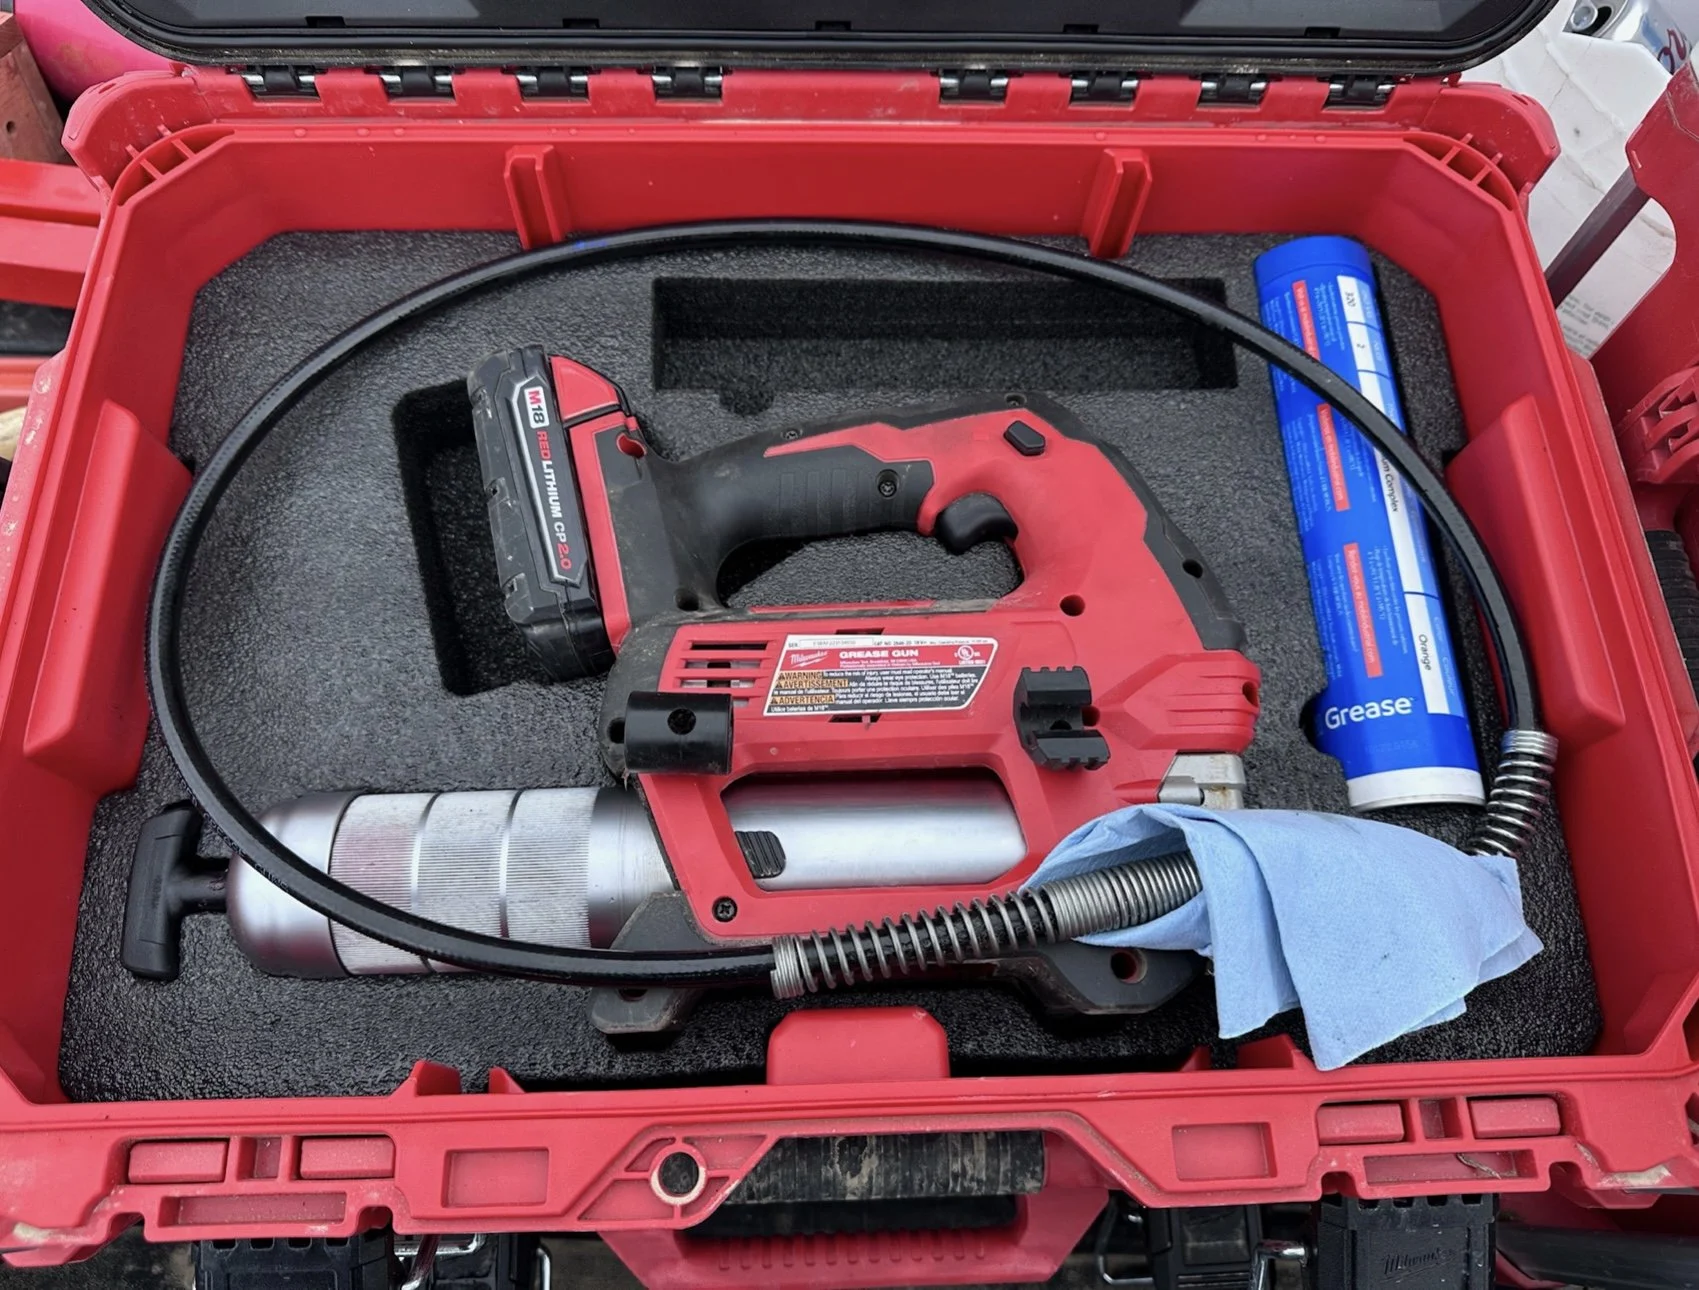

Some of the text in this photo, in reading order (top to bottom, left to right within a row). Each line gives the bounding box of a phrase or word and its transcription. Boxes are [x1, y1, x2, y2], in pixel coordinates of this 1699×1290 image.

[1345, 291, 1357, 308] 320
[528, 390, 546, 424] M18
[537, 430, 563, 519] REDLITHIUM
[1385, 471, 1398, 512] Complex
[839, 649, 919, 659] GREASE GUN
[1418, 633, 1431, 671] Orange
[784, 672, 822, 680] WARNING
[784, 679, 848, 688] AVERTISSEMENT
[780, 695, 834, 704] ADVERTENCIA
[1325, 697, 1413, 730] Grease
